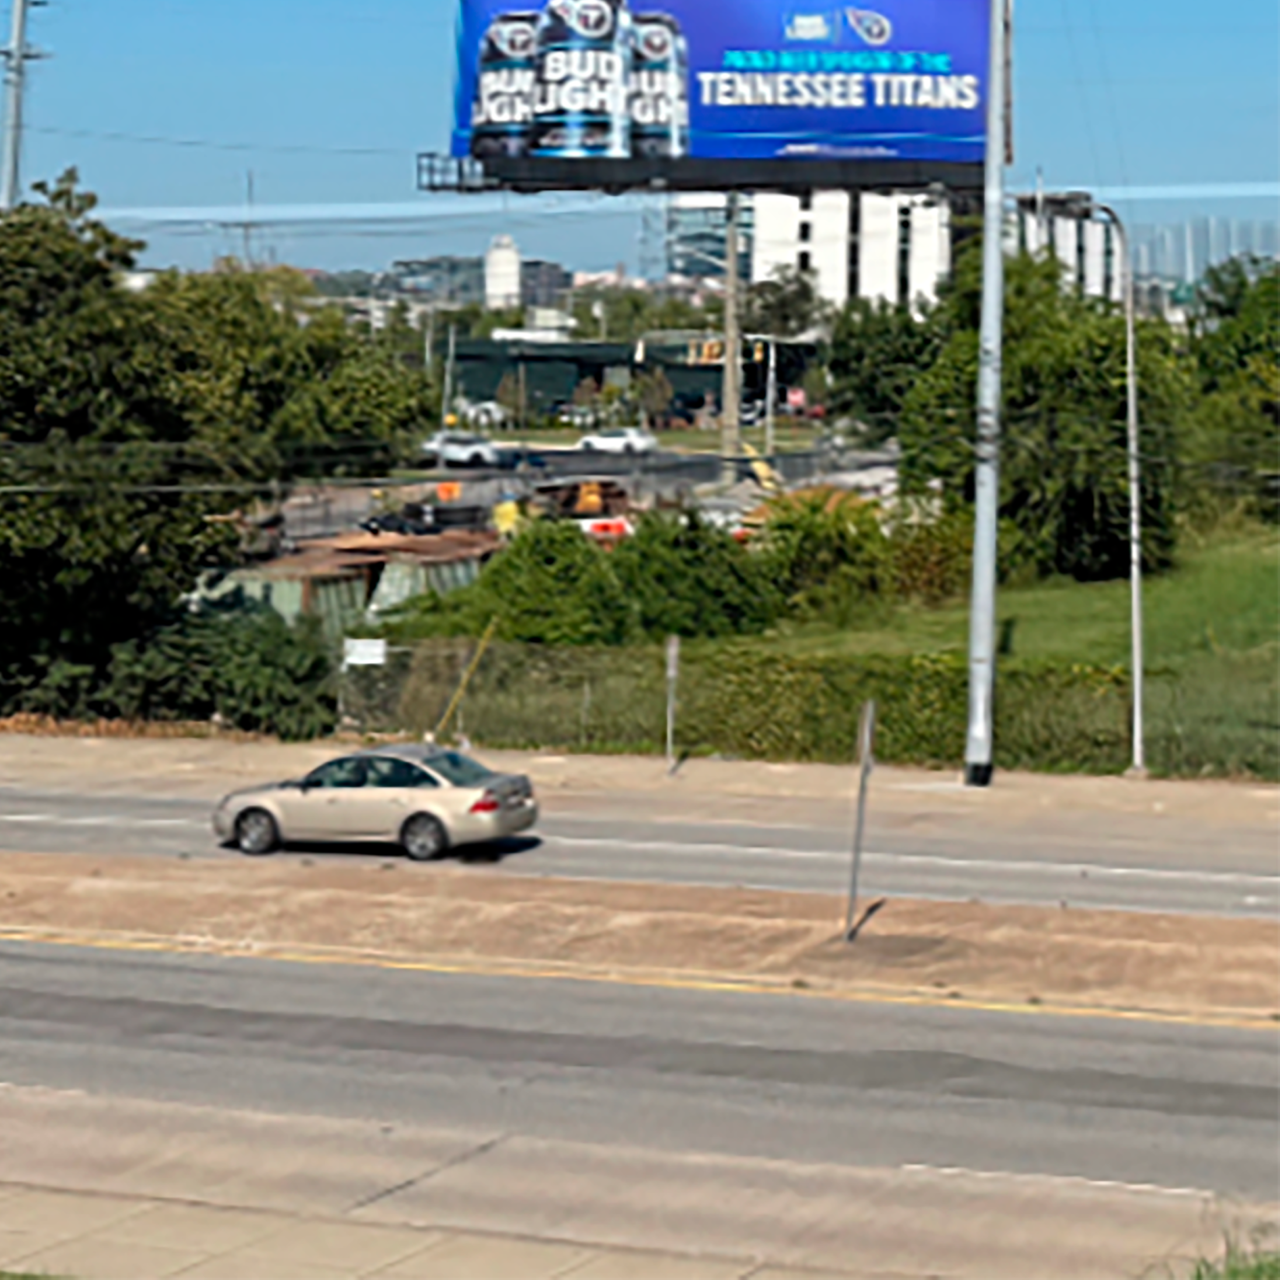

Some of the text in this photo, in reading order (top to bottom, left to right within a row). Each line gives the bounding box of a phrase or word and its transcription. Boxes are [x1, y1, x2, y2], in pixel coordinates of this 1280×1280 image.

[545, 51, 623, 81] BUD
[697, 72, 979, 109] TENNESSEE TITANS
